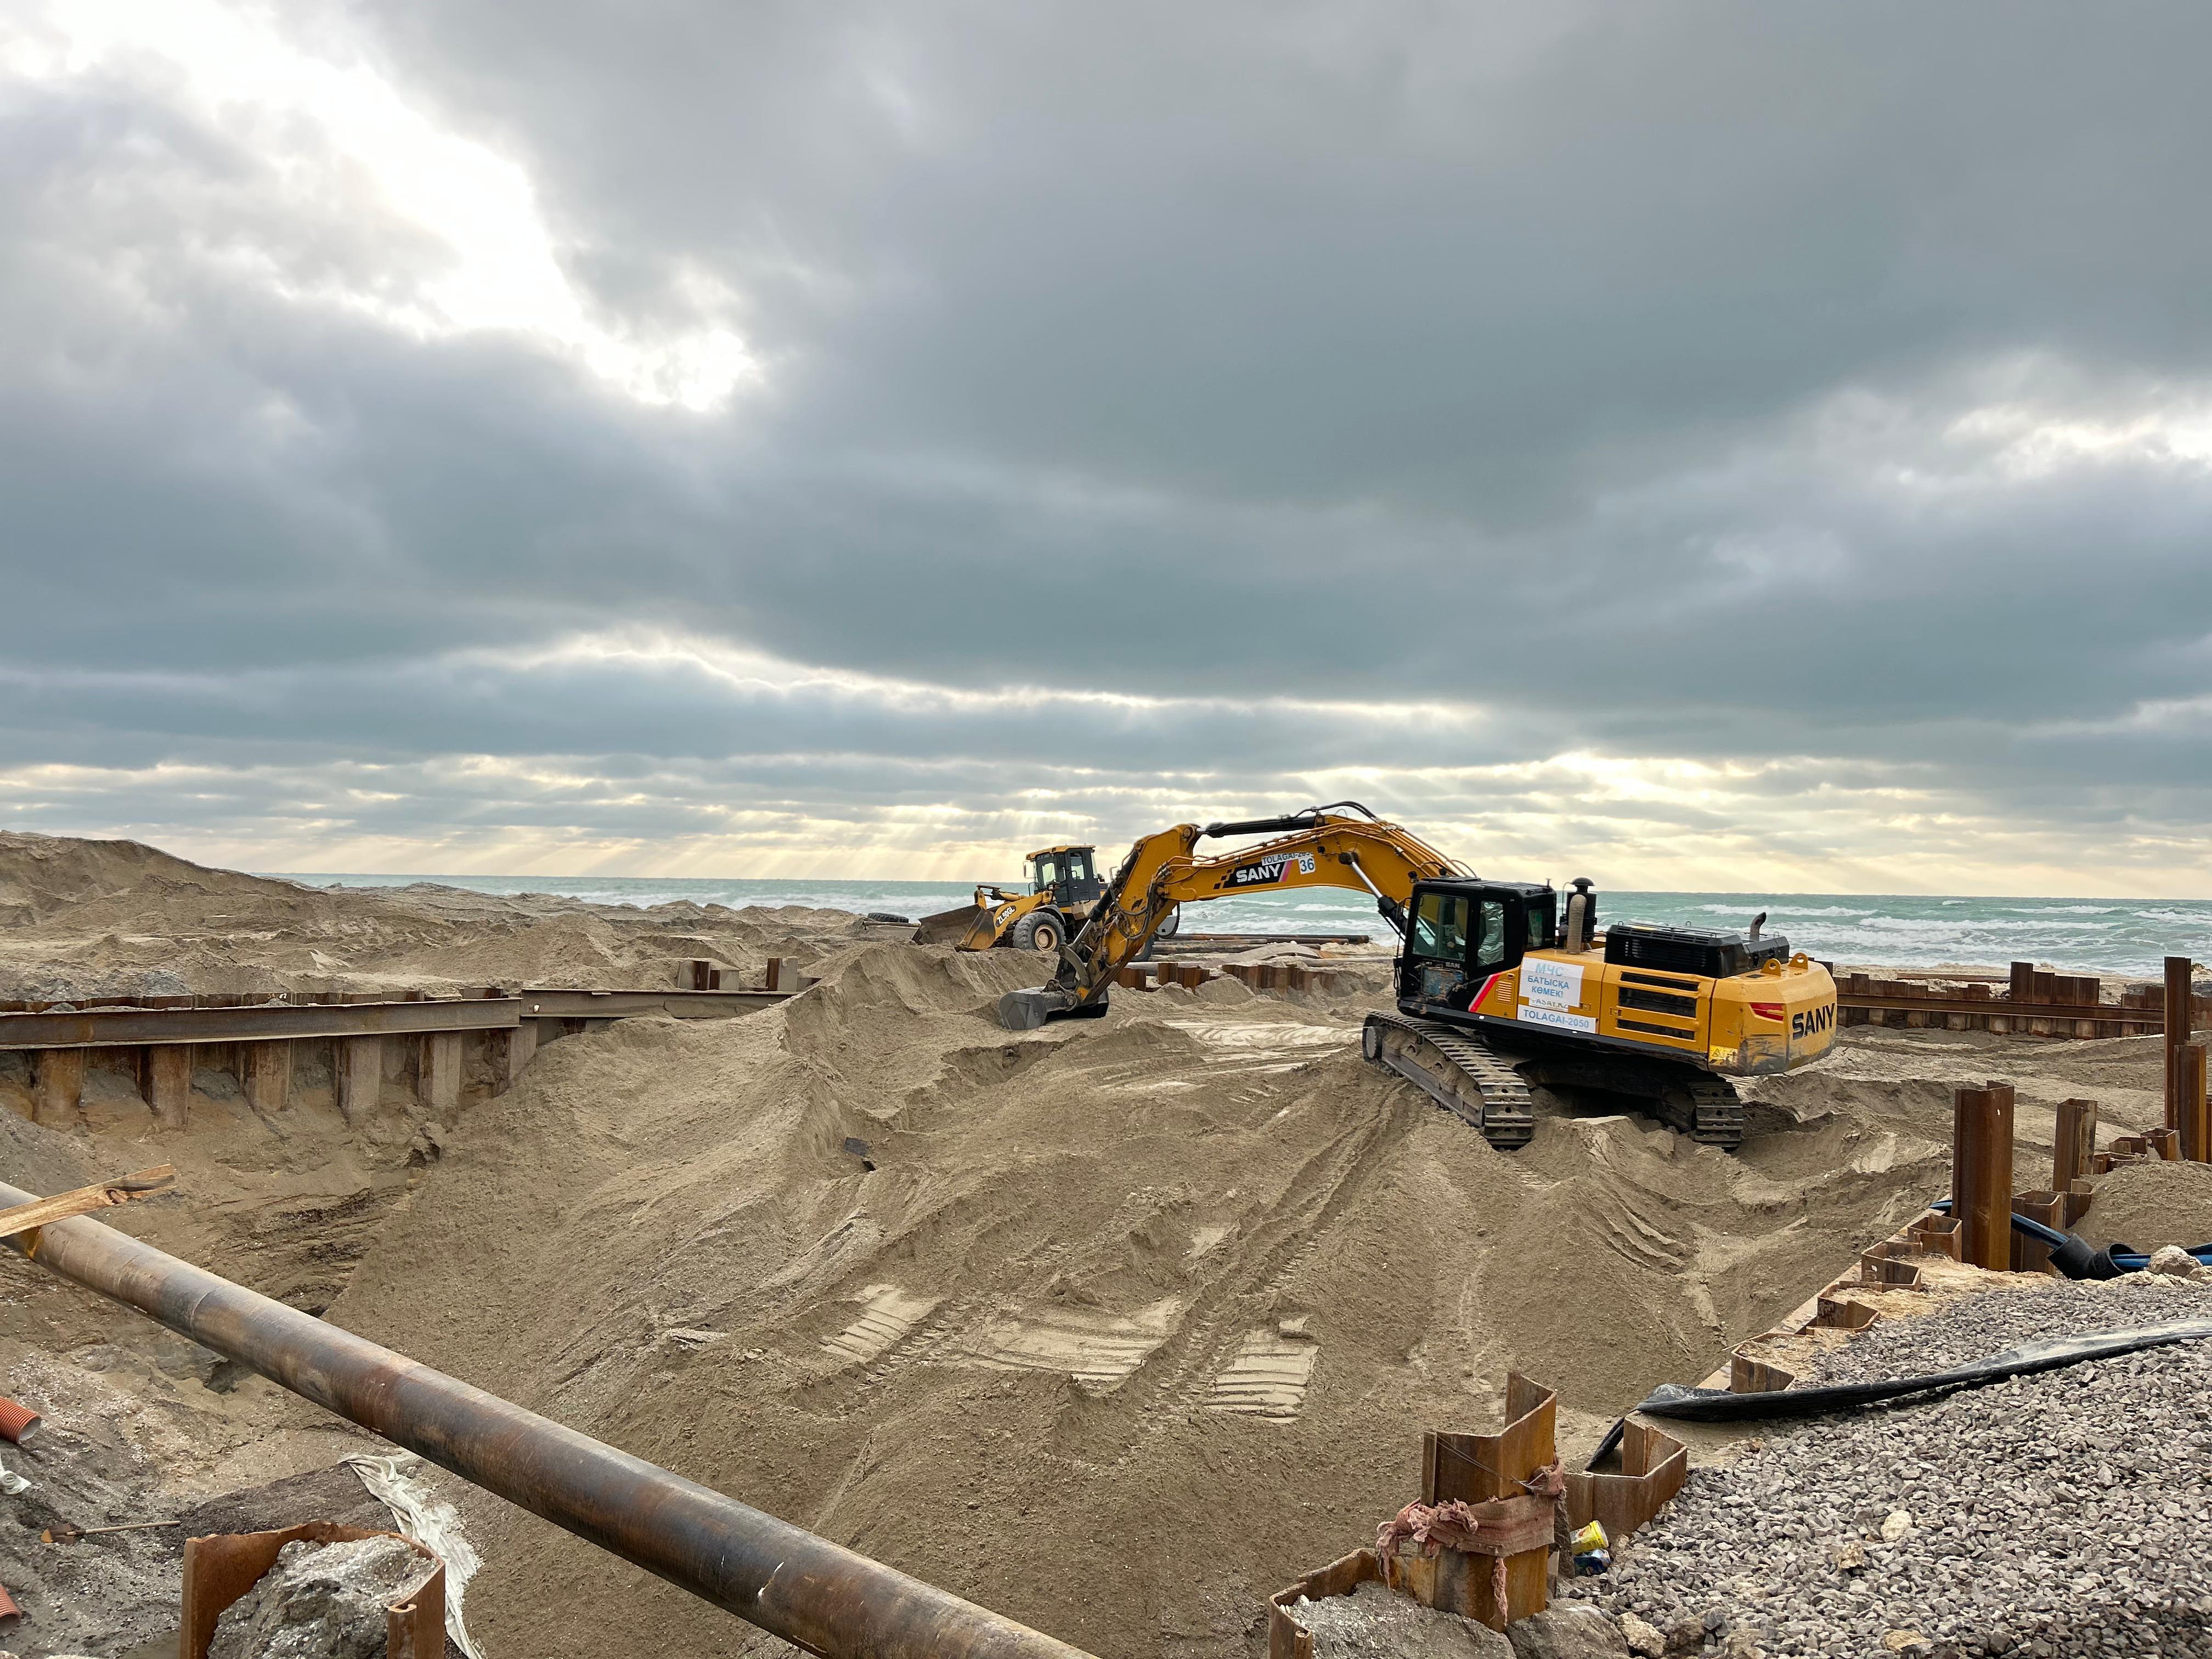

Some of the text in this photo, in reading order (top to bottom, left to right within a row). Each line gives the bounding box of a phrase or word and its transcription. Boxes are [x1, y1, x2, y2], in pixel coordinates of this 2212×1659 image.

[1300, 858, 1314, 871] 36
[1236, 864, 1280, 883] SANY
[1527, 975, 1570, 990] БАТЫСҚА
[1531, 985, 1564, 998] КӨМЕК!
[1523, 1009, 1589, 1029] TOLAGAI-2050
[1792, 1003, 1835, 1040] SANY
